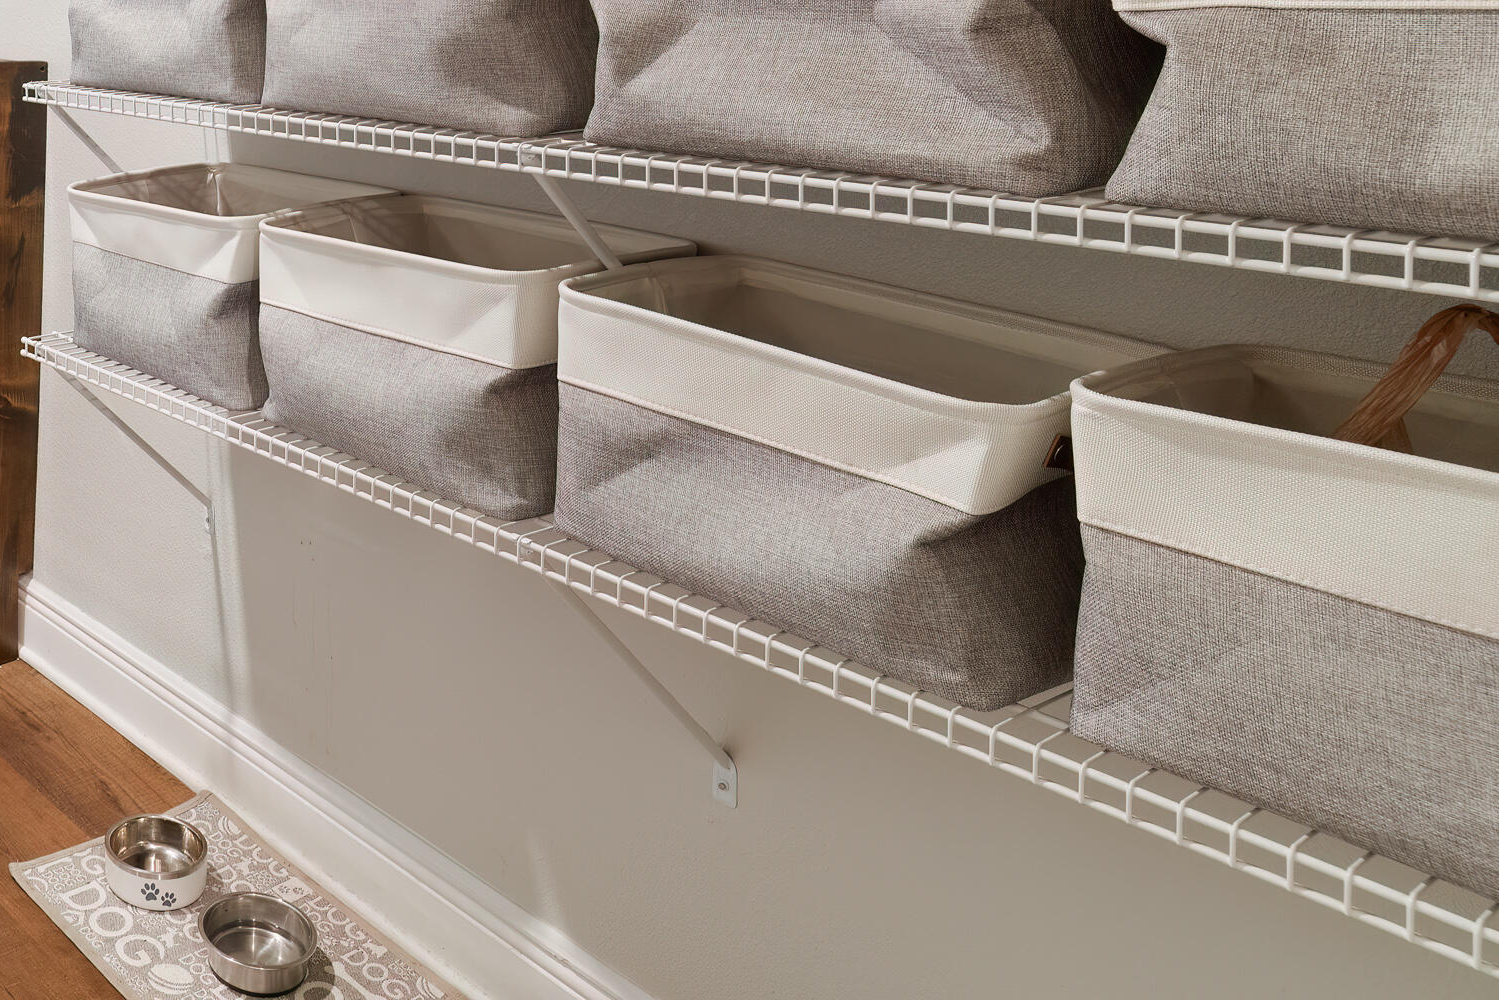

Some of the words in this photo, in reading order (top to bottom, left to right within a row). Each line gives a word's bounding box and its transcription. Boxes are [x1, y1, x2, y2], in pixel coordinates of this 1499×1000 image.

[207, 846, 229, 863] OG
[209, 831, 242, 857] DOG
[59, 880, 165, 967] DOG
[79, 926, 105, 949] DOG
[178, 953, 219, 985] DOG
[341, 948, 412, 1000] DOG
